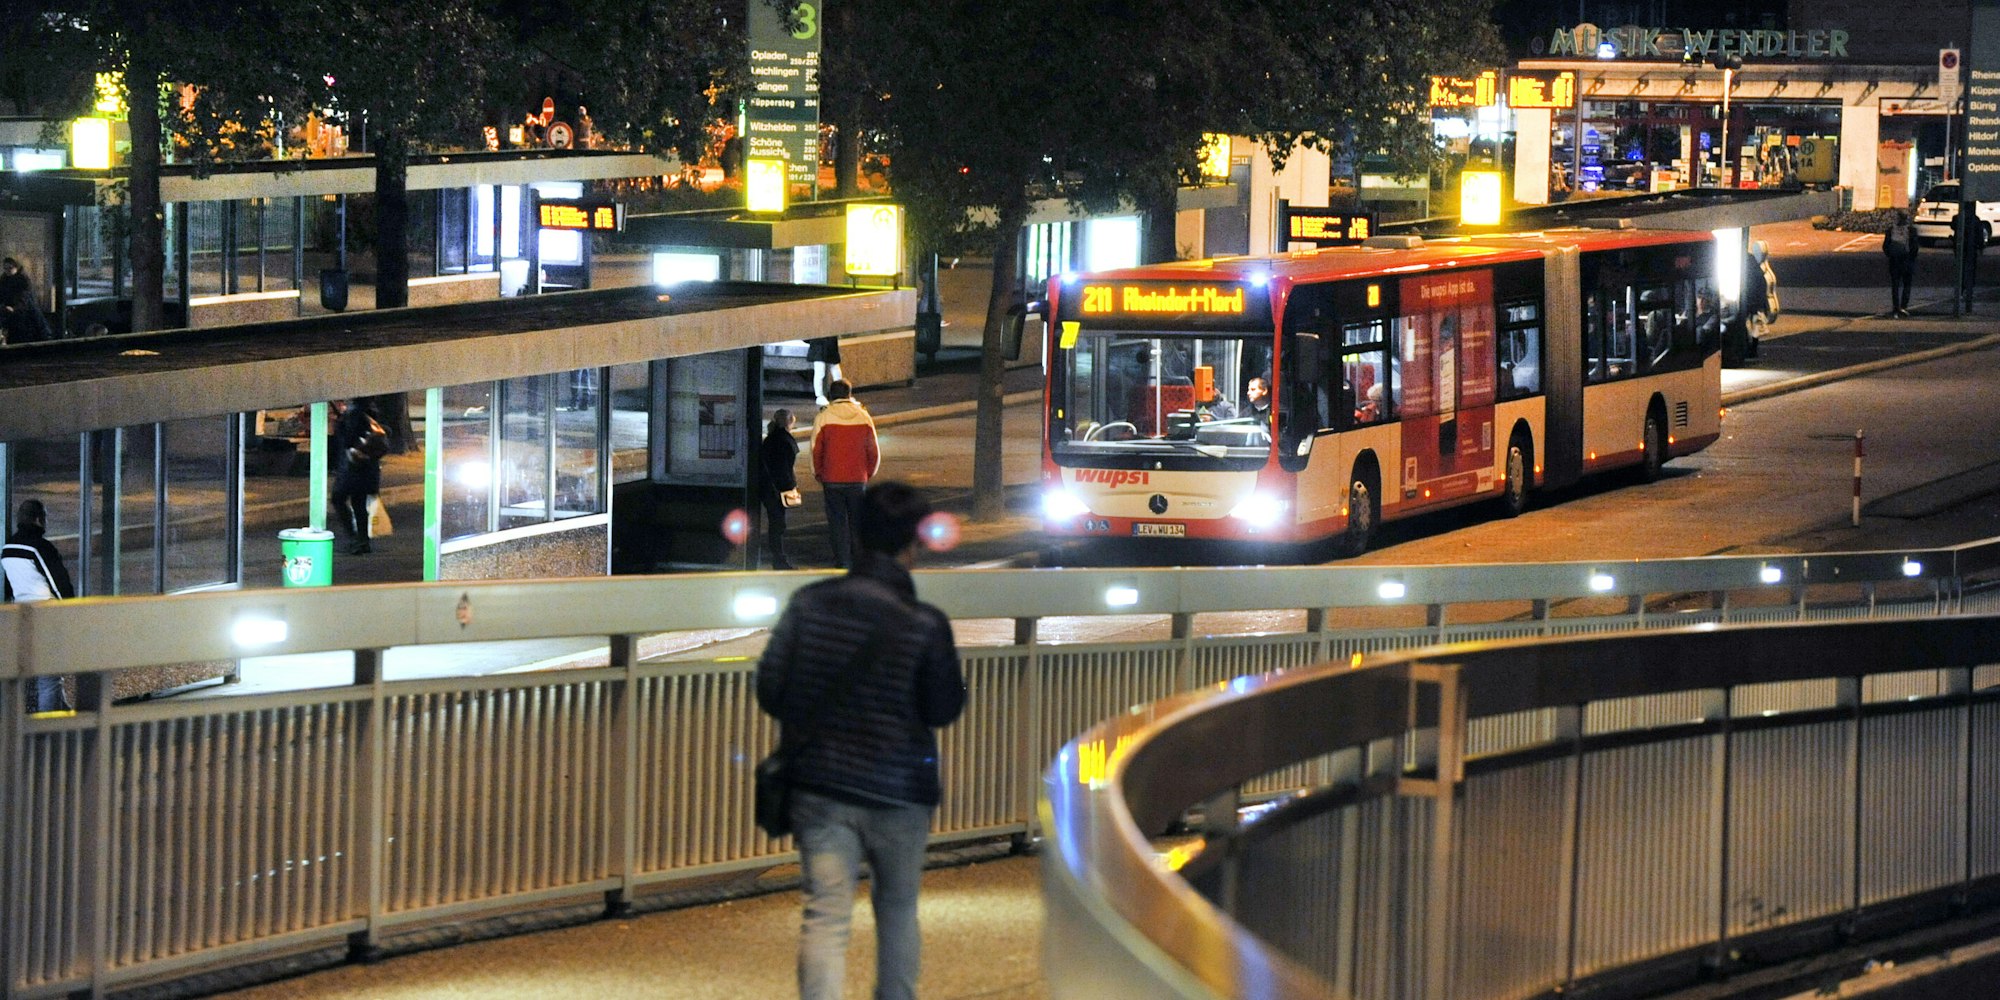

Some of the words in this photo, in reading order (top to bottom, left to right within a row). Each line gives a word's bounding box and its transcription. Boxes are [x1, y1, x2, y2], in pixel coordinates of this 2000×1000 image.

[791, 3, 816, 39] 3
[751, 50, 787, 61] Opladen
[751, 66, 799, 77] Leichlingen
[755, 82, 788, 92] olingen
[1970, 100, 1997, 112] Bürrig
[750, 121, 797, 132] Witzhelden
[1968, 131, 1998, 141] Hitdorf
[750, 137, 783, 147] Schöne
[1800, 158, 1813, 167] 1A
[1083, 286, 1112, 312] 211
[1123, 287, 1243, 313] Rheindorf-Nord
[1075, 469, 1149, 488] wupsi
[1138, 524, 1153, 534] LEV
[1170, 525, 1184, 535] 134
